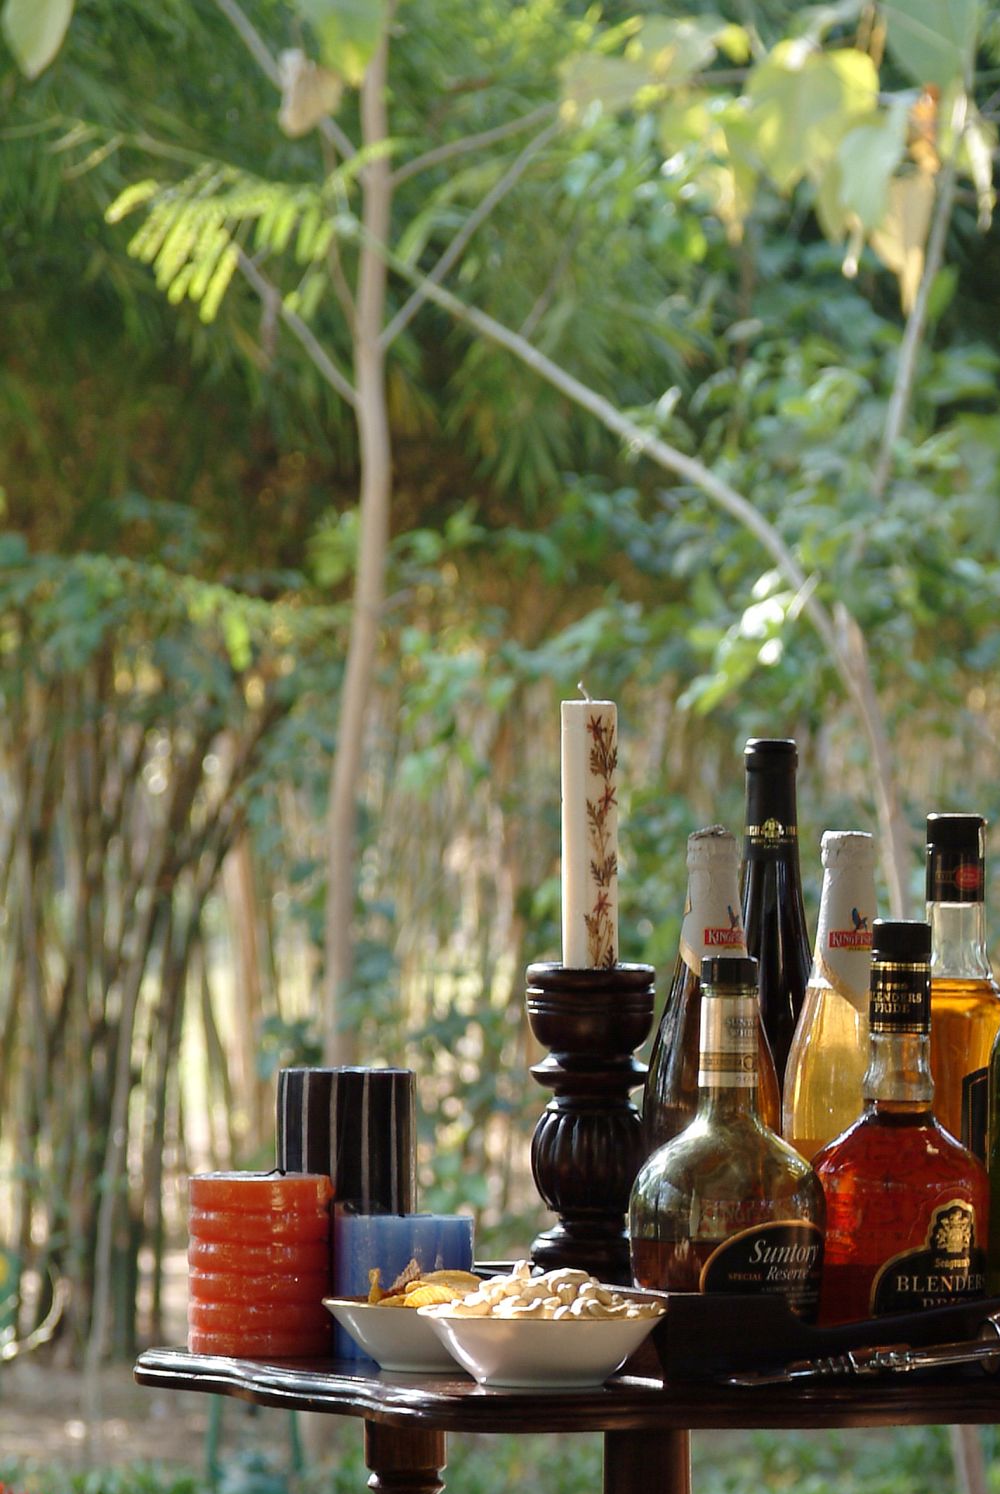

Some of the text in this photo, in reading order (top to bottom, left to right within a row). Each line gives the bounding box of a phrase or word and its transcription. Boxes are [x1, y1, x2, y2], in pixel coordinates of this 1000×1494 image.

[748, 1239, 820, 1268] Suntory
[728, 1265, 809, 1281] SPECIAL Reserve
